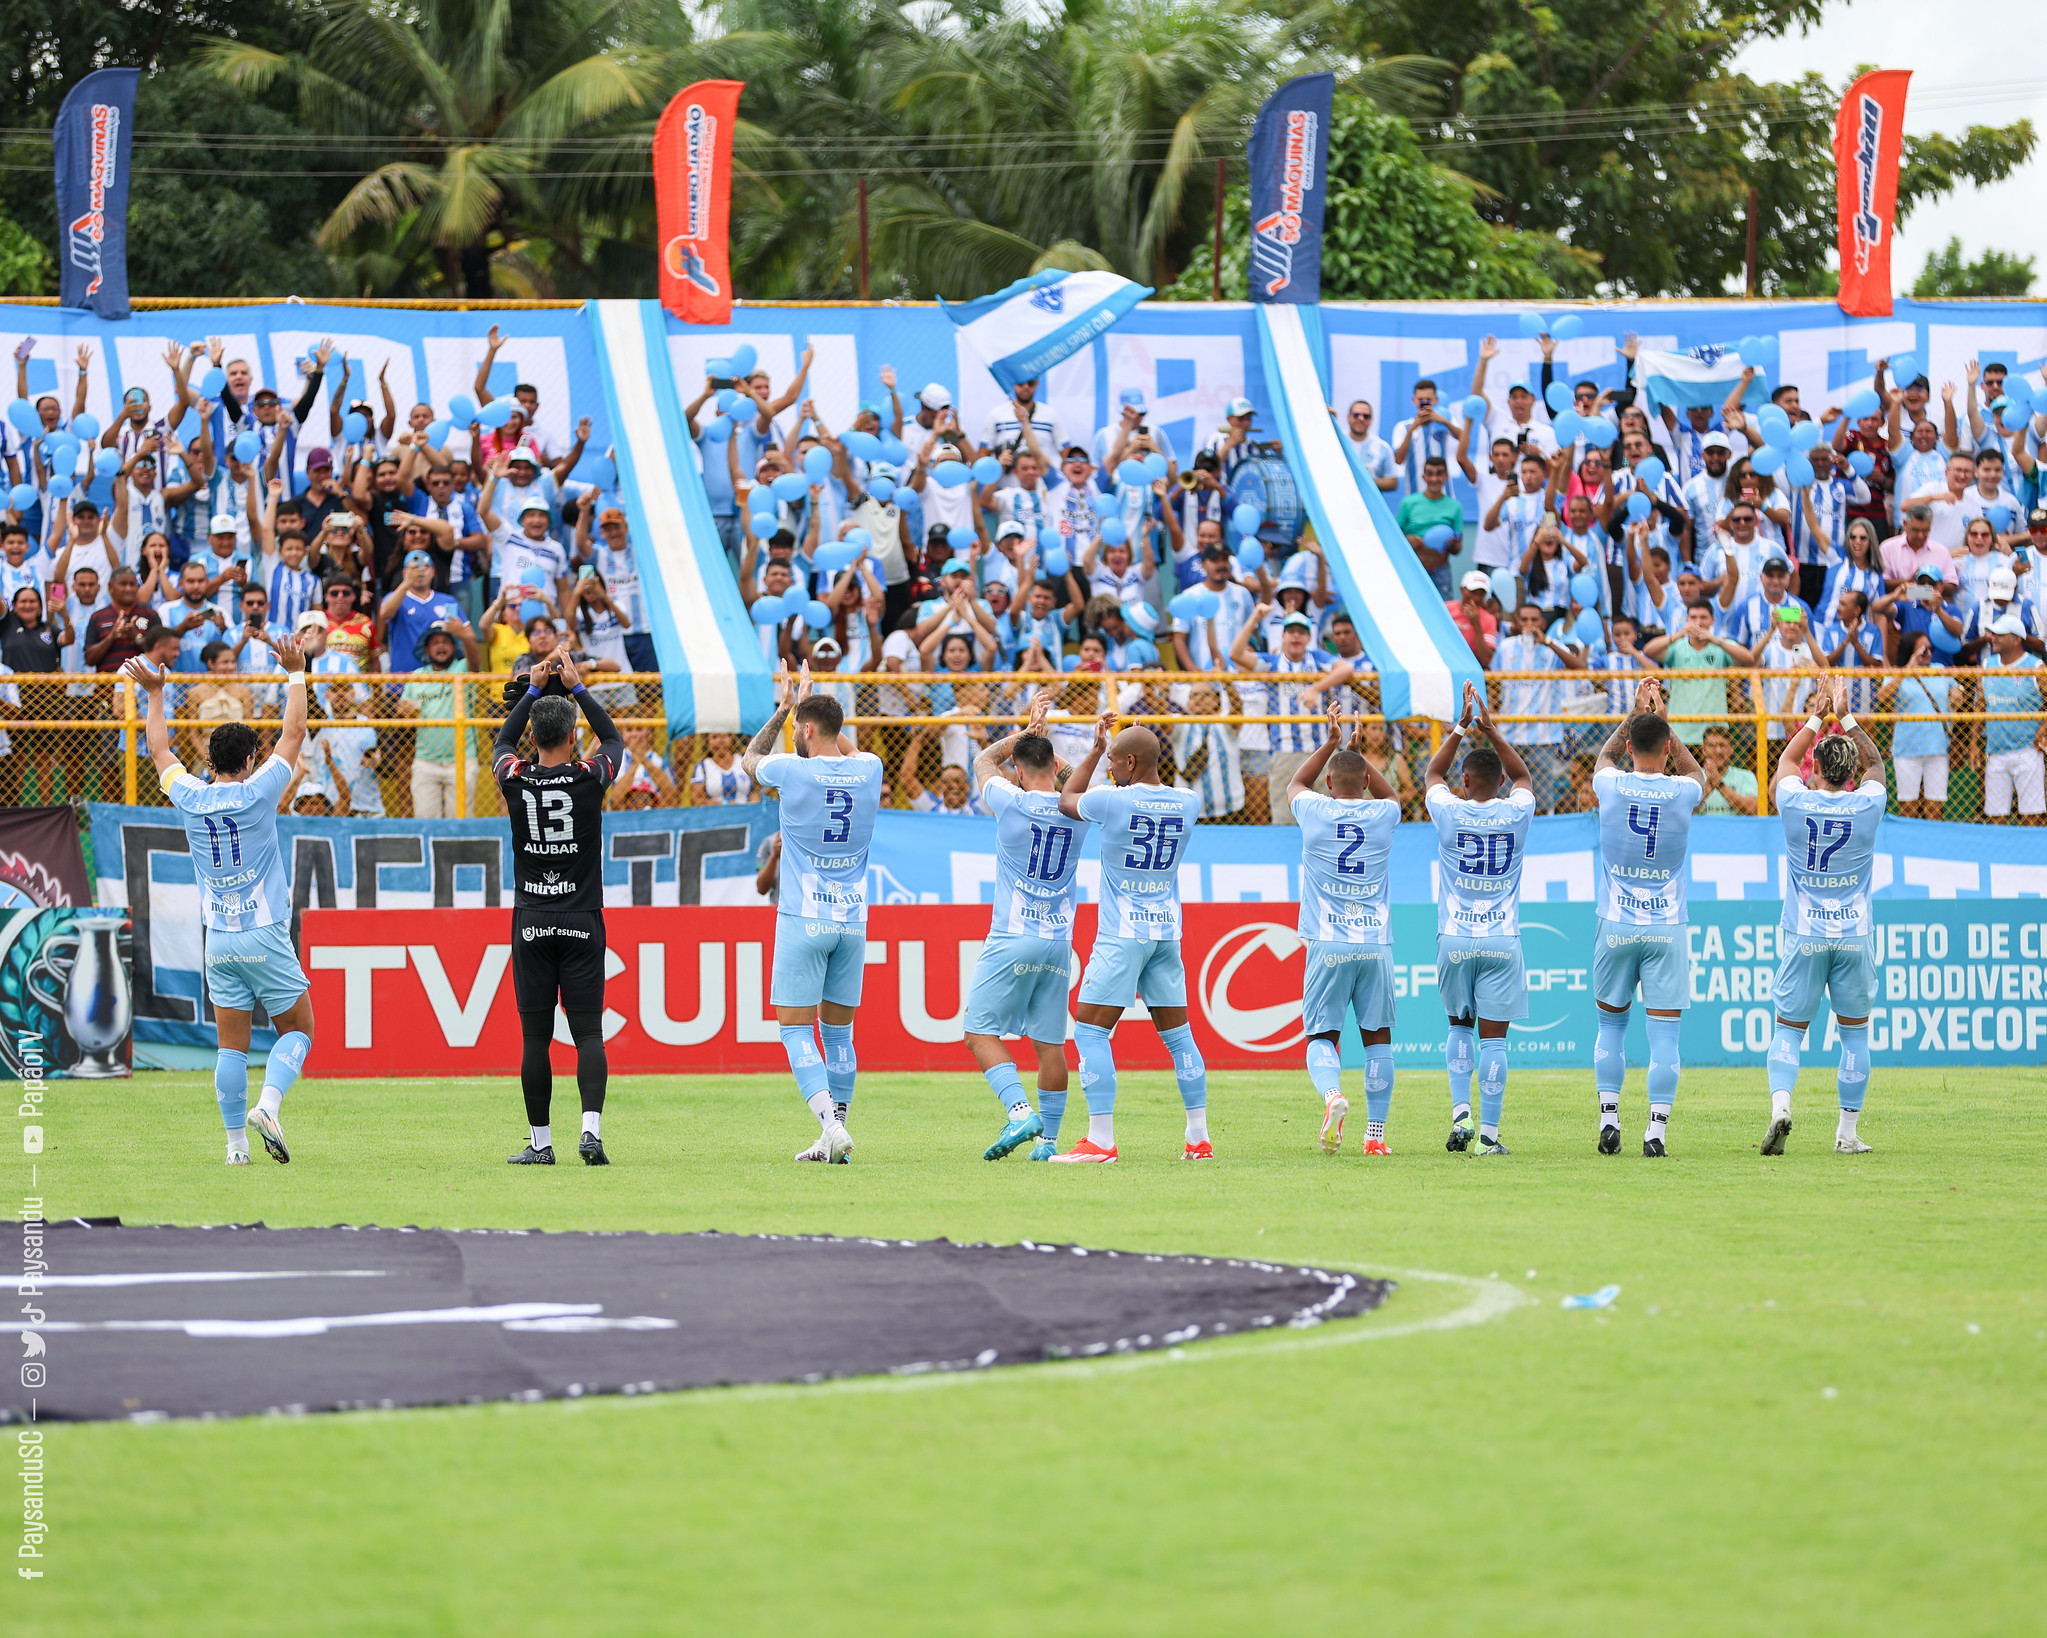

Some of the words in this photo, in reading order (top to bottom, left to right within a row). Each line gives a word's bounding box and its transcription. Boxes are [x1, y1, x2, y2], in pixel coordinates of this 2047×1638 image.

[685, 106, 703, 166] JADÃO
[91, 105, 108, 210] MÁQUINAS
[1281, 111, 1307, 211] MÁQUINAS
[1281, 214, 1301, 242] SÓ
[813, 774, 867, 784] REVEMAR
[1618, 787, 1674, 800] REVEMAR
[1133, 800, 1184, 811] REVEMAR
[1325, 807, 1377, 818] REVEMAR
[522, 789, 574, 842] 13
[822, 788, 855, 843] 3
[1457, 817, 1513, 827] REVEMAR
[1627, 803, 1661, 860] 4
[203, 815, 243, 869] 11
[524, 843, 579, 855] ALUBAR
[1123, 814, 1184, 871] 36
[1336, 822, 1367, 875] 2
[1805, 815, 1854, 873] 17
[1027, 822, 1074, 882] 10
[1611, 864, 1671, 880] ALUBAR
[524, 881, 577, 895] mirella
[1120, 879, 1171, 893] ALUBAR
[1322, 882, 1380, 896] ALUBAR
[1454, 876, 1512, 892] ALUBAR
[1799, 874, 1859, 888] ALUBAR
[1617, 894, 1669, 910] mirella
[1129, 909, 1176, 924] mirella
[1328, 912, 1382, 927] mirella
[1454, 909, 1506, 924] mirella
[1807, 906, 1860, 921] mirella
[536, 926, 591, 940] UniCesumar
[1618, 934, 1674, 946] UniCesumar
[1968, 923, 2010, 960] DE
[1461, 948, 1512, 961] UniCesumar
[310, 944, 513, 1048] TV
[1720, 1007, 1810, 1053] CO
